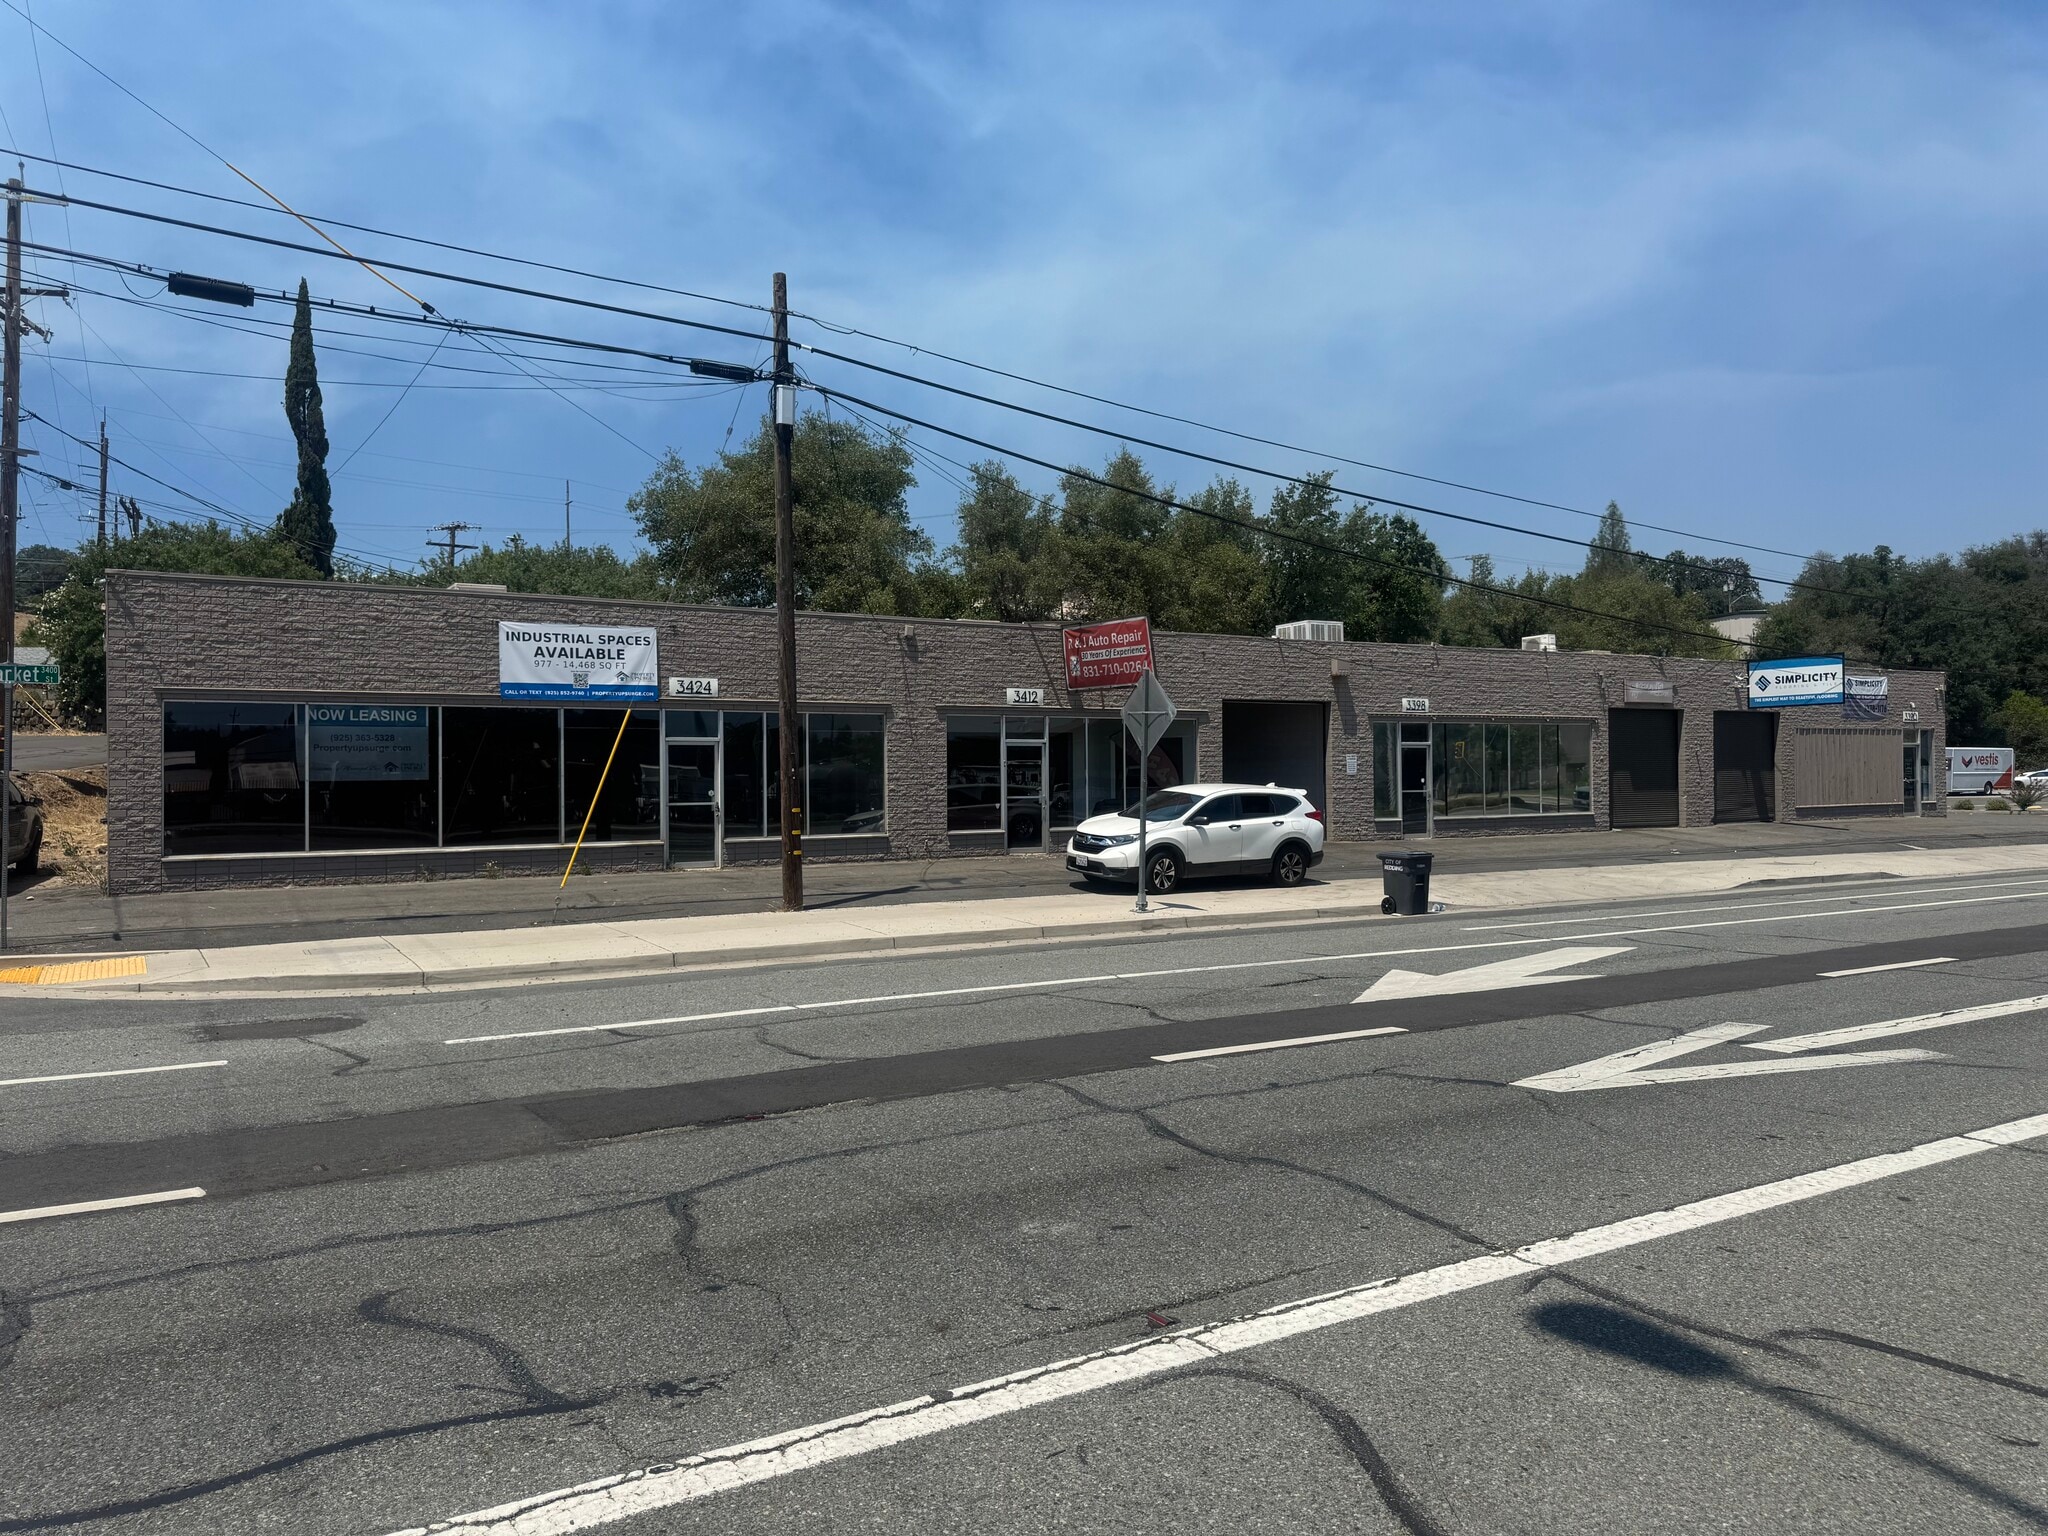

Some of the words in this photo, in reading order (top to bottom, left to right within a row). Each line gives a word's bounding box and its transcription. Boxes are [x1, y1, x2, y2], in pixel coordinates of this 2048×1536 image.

[505, 631, 594, 644] INDUSTRIAL
[598, 634, 651, 646] SPACES
[1068, 638, 1074, 649] R
[1088, 635, 1109, 647] Auto
[1111, 629, 1142, 645] Repair
[533, 646, 626, 660] AVAILABLE
[1082, 652, 1088, 660] 30
[1089, 651, 1104, 659] Years
[1104, 649, 1112, 658] Of
[1113, 646, 1146, 657] Experience
[41, 666, 58, 674] 3400
[534, 660, 552, 668] 977
[563, 661, 596, 670] 14,468
[599, 661, 612, 670] SQ
[615, 662, 627, 670] FT
[1083, 660, 1148, 678] 831-710-0264
[45, 675, 53, 683] St
[1775, 671, 1838, 685] SIMPLICITY
[1855, 679, 1882, 687] SIMPLICITY
[676, 680, 712, 695] 3424
[1013, 690, 1038, 703] 3412
[1406, 700, 1426, 711] 3398
[308, 709, 345, 720] NOW
[350, 709, 417, 721] LEASING
[330, 734, 353, 742] (925)
[355, 734, 395, 742] 363-5328
[1974, 753, 1999, 765] vestis
[1384, 864, 1404, 872] REDDING
